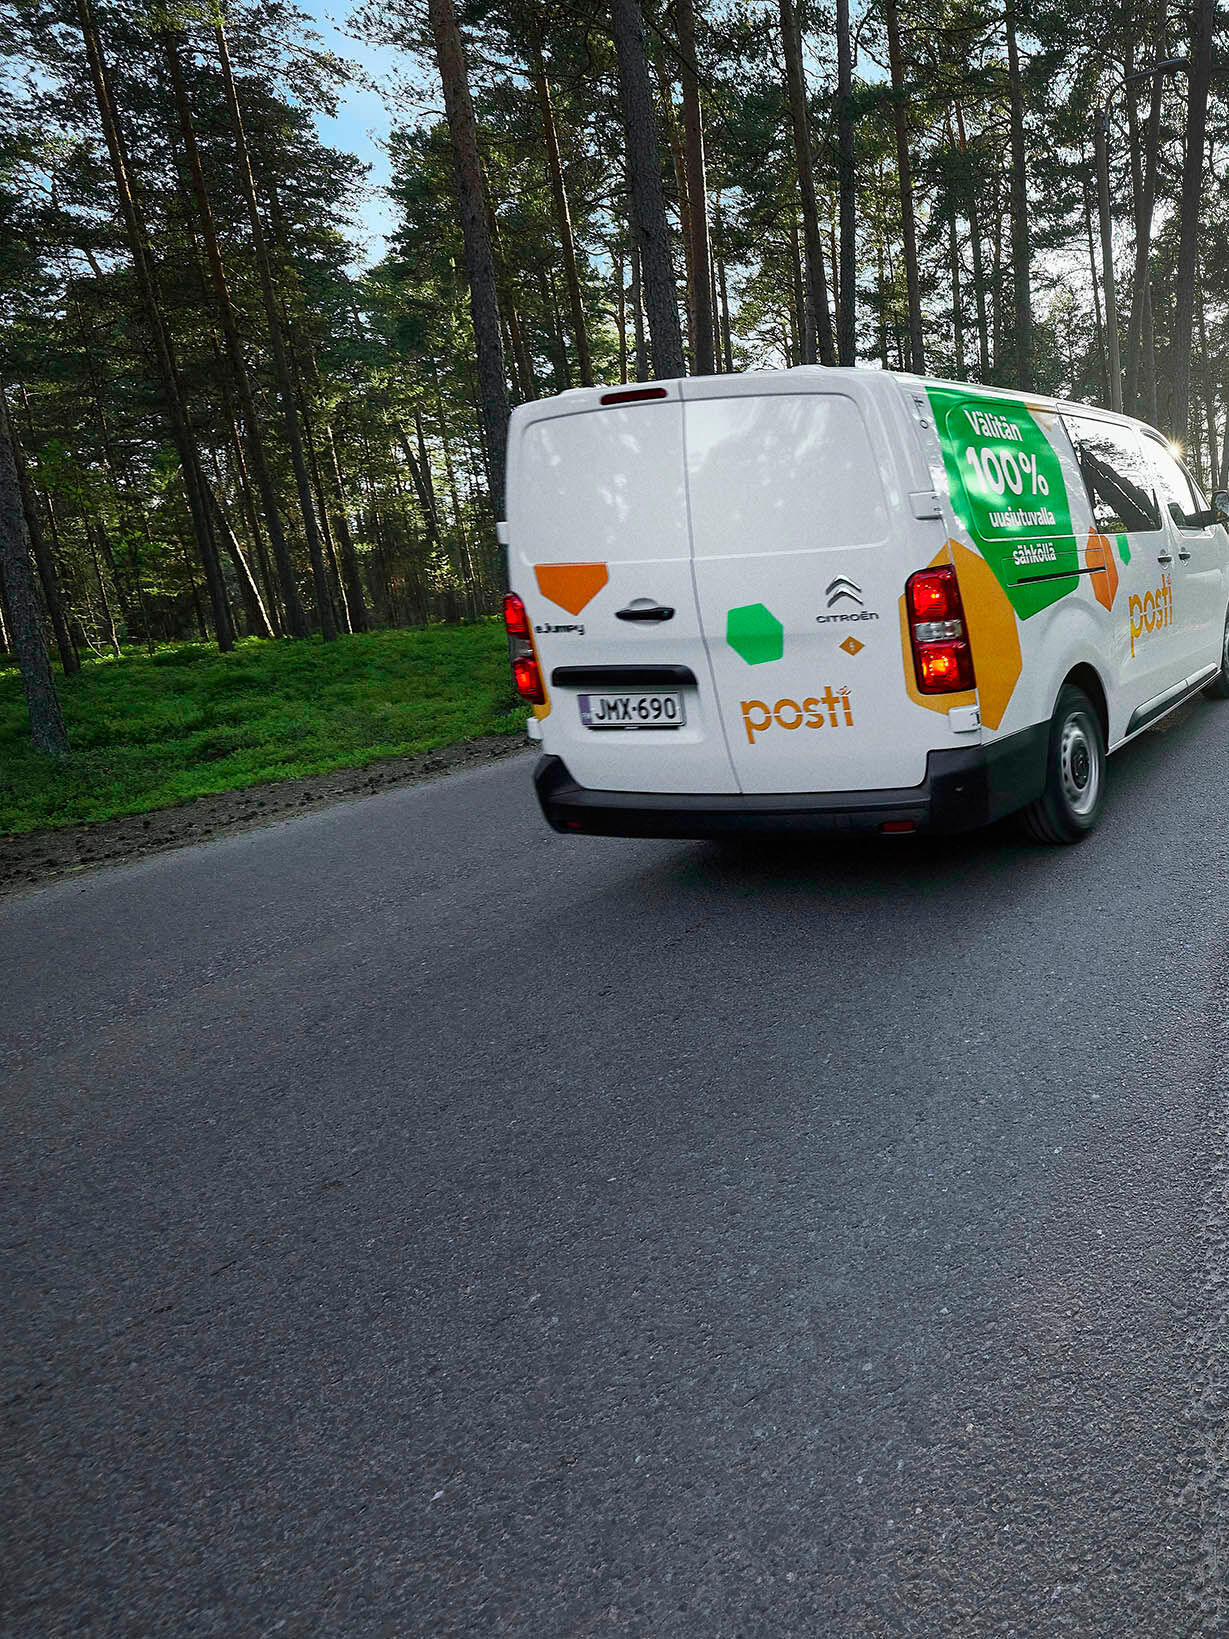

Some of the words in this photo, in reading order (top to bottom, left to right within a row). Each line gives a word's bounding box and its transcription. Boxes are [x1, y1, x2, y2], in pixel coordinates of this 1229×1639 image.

[964, 410, 1023, 441] Välitän
[965, 446, 1049, 496] 100%
[988, 506, 1056, 528] uusiutuvalla
[1012, 542, 1057, 565] sähköllä
[1128, 573, 1173, 658] posti
[595, 697, 676, 720] JMX-690
[740, 685, 853, 744] posti
